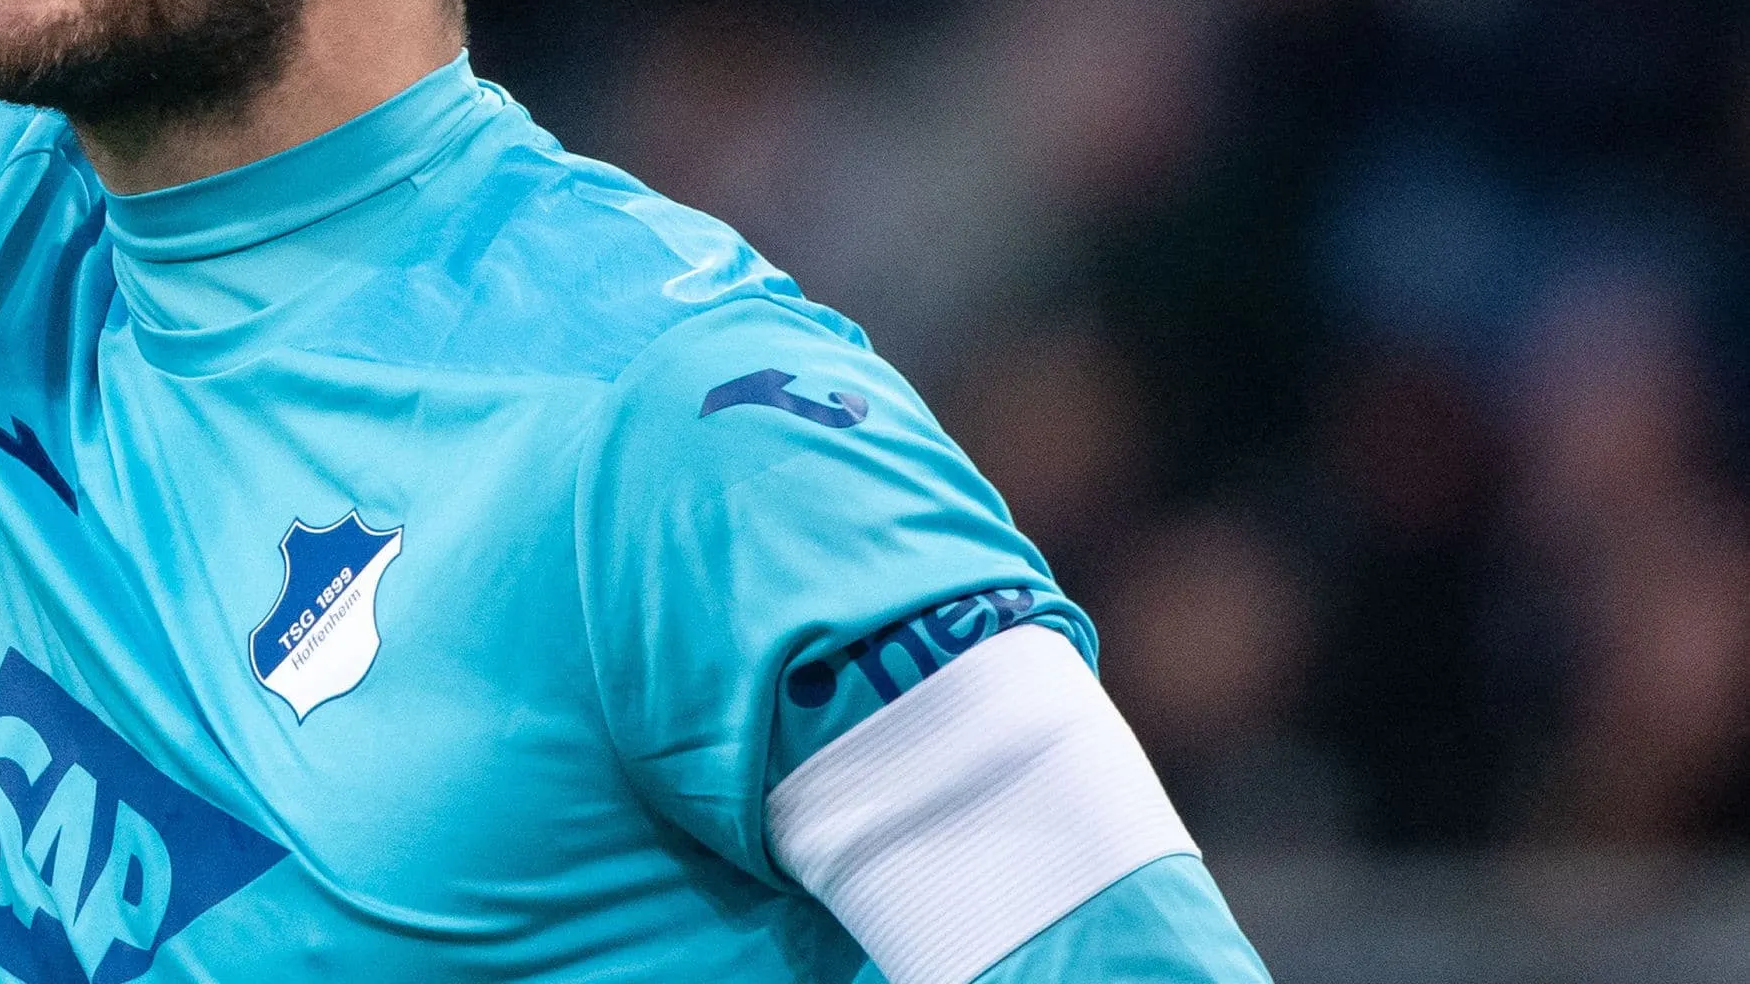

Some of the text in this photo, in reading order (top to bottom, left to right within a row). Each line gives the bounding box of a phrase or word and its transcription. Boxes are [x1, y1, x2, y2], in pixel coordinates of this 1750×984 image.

[278, 567, 353, 650] TSG 1899
[292, 588, 361, 670] Hoffenheim
